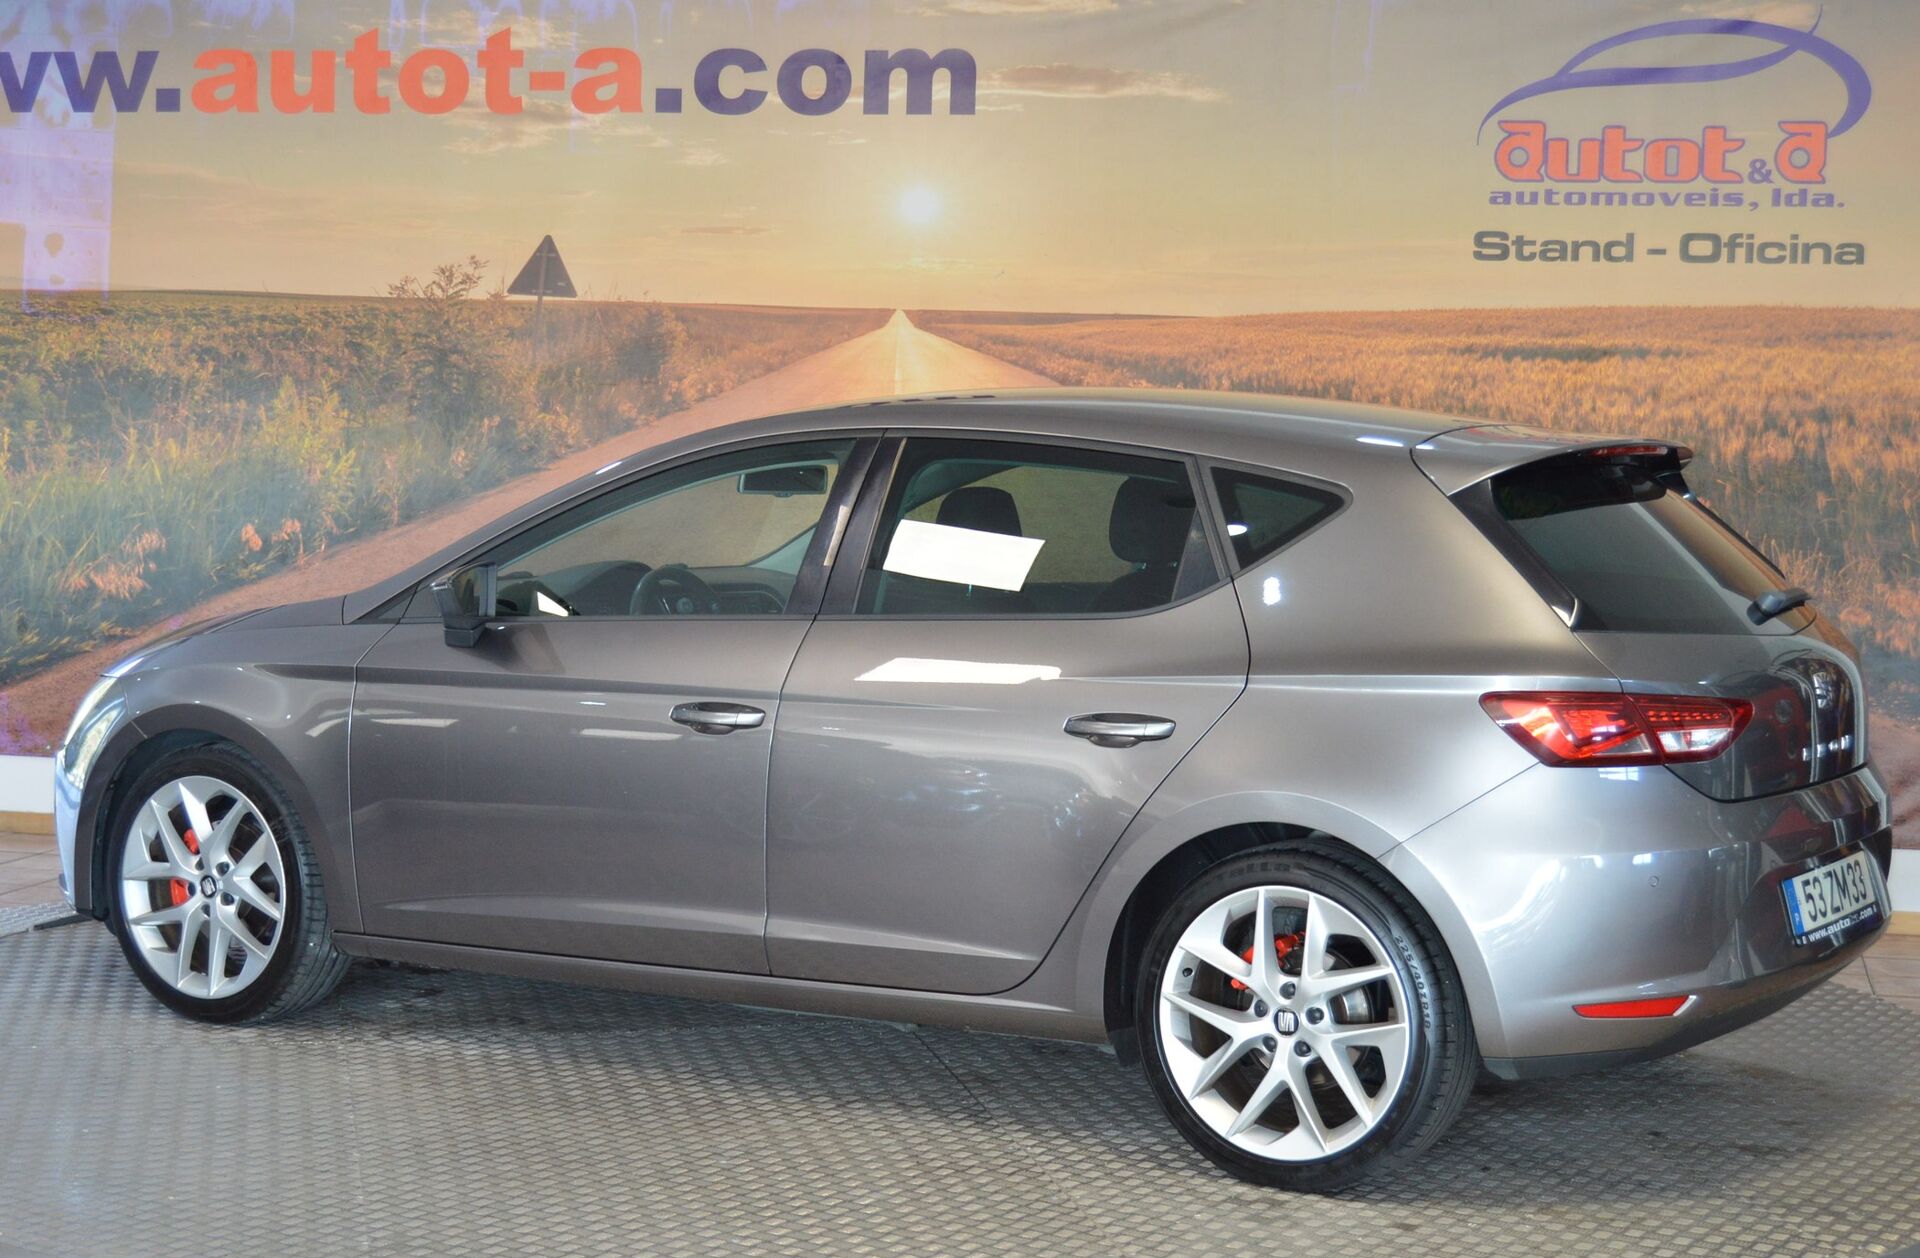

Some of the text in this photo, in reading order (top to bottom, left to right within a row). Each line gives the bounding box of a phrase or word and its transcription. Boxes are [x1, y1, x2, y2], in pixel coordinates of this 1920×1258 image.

[1488, 188, 1845, 211] automoveis, lda.
[1472, 230, 1635, 263] Stand
[1679, 232, 1866, 265] Oficina
